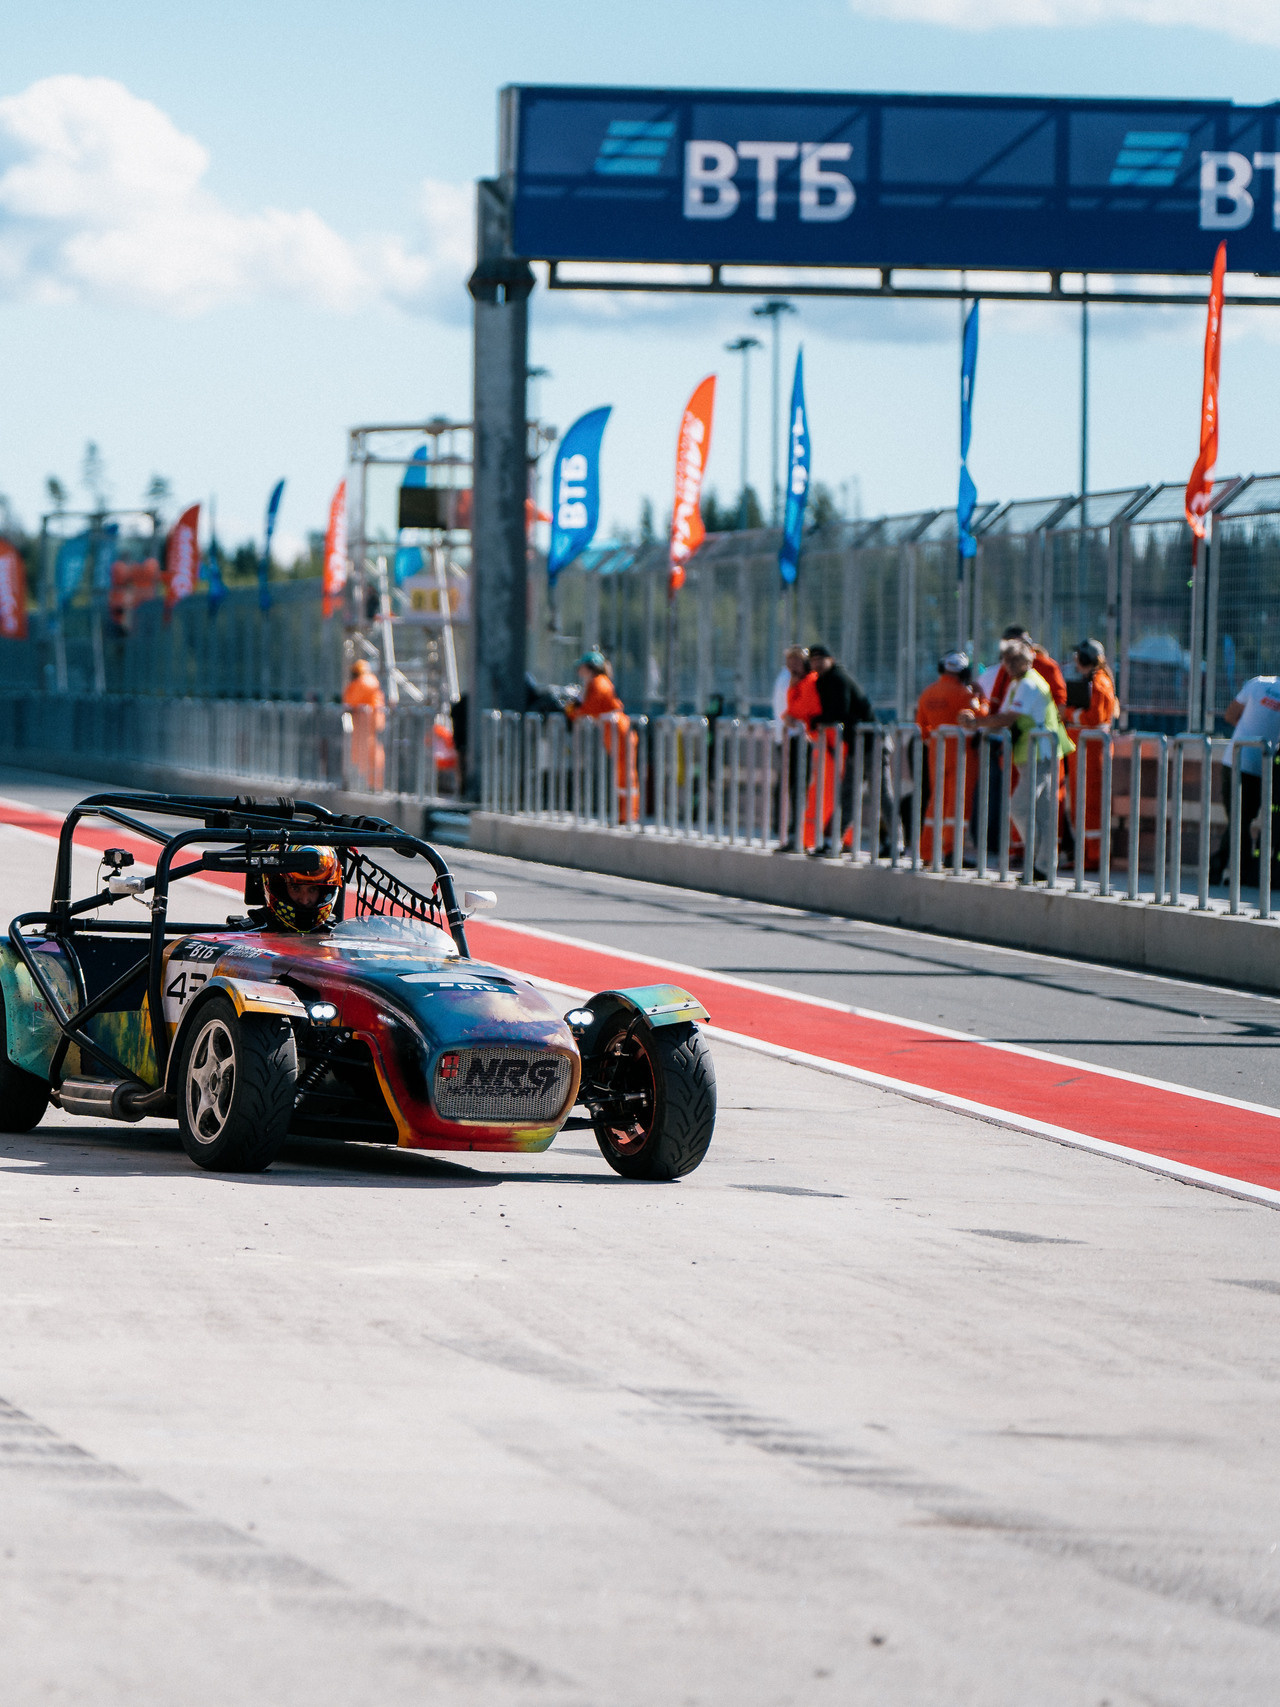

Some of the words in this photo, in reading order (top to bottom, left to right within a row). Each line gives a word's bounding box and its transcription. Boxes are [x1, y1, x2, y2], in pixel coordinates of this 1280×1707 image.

[684, 139, 857, 222] ВТБ
[557, 454, 588, 529] ВТБ
[189, 943, 220, 959] ВТБ
